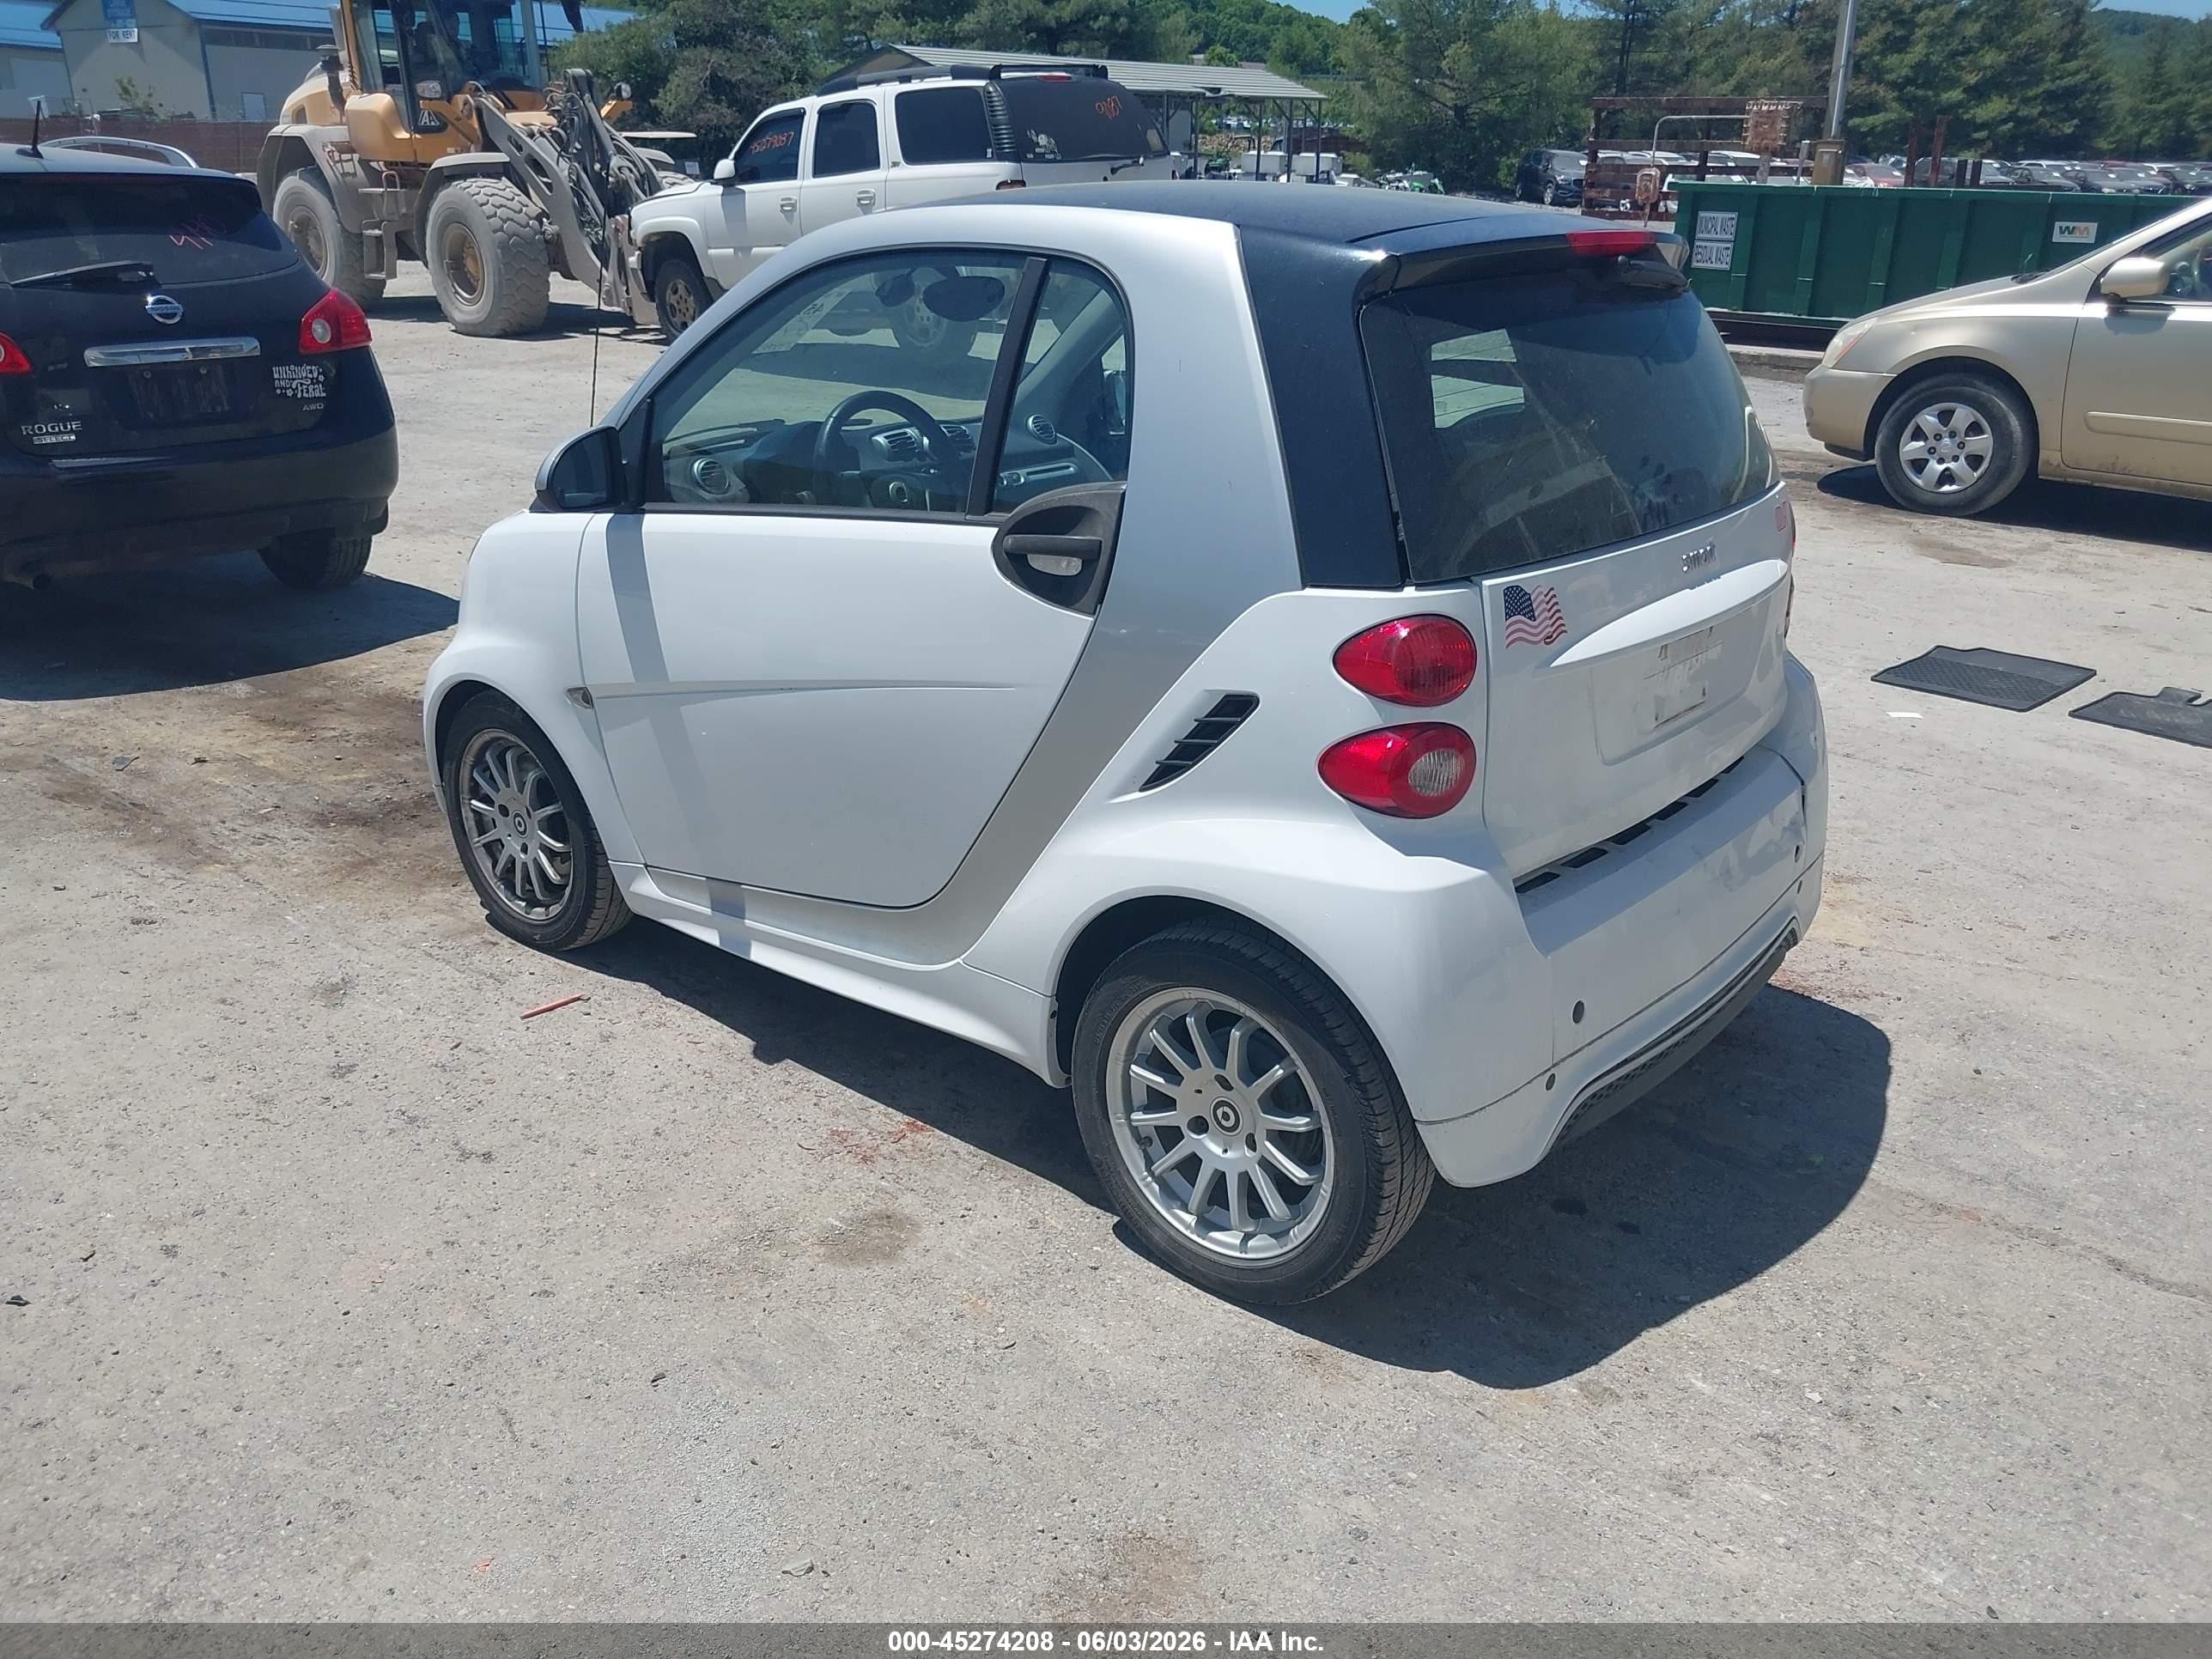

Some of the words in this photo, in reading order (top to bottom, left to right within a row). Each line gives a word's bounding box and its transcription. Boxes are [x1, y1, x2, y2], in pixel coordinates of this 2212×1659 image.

[109, 31, 119, 40] FOR
[122, 30, 137, 40] RENT
[1719, 216, 1735, 235] WASTE
[2058, 225, 2090, 235] WM
[1694, 245, 1714, 264] RESIDUAL
[1715, 246, 1730, 264] WASTE
[302, 403, 324, 411] AWD
[21, 421, 82, 435] ROGUE
[36, 434, 76, 443] SELECT
